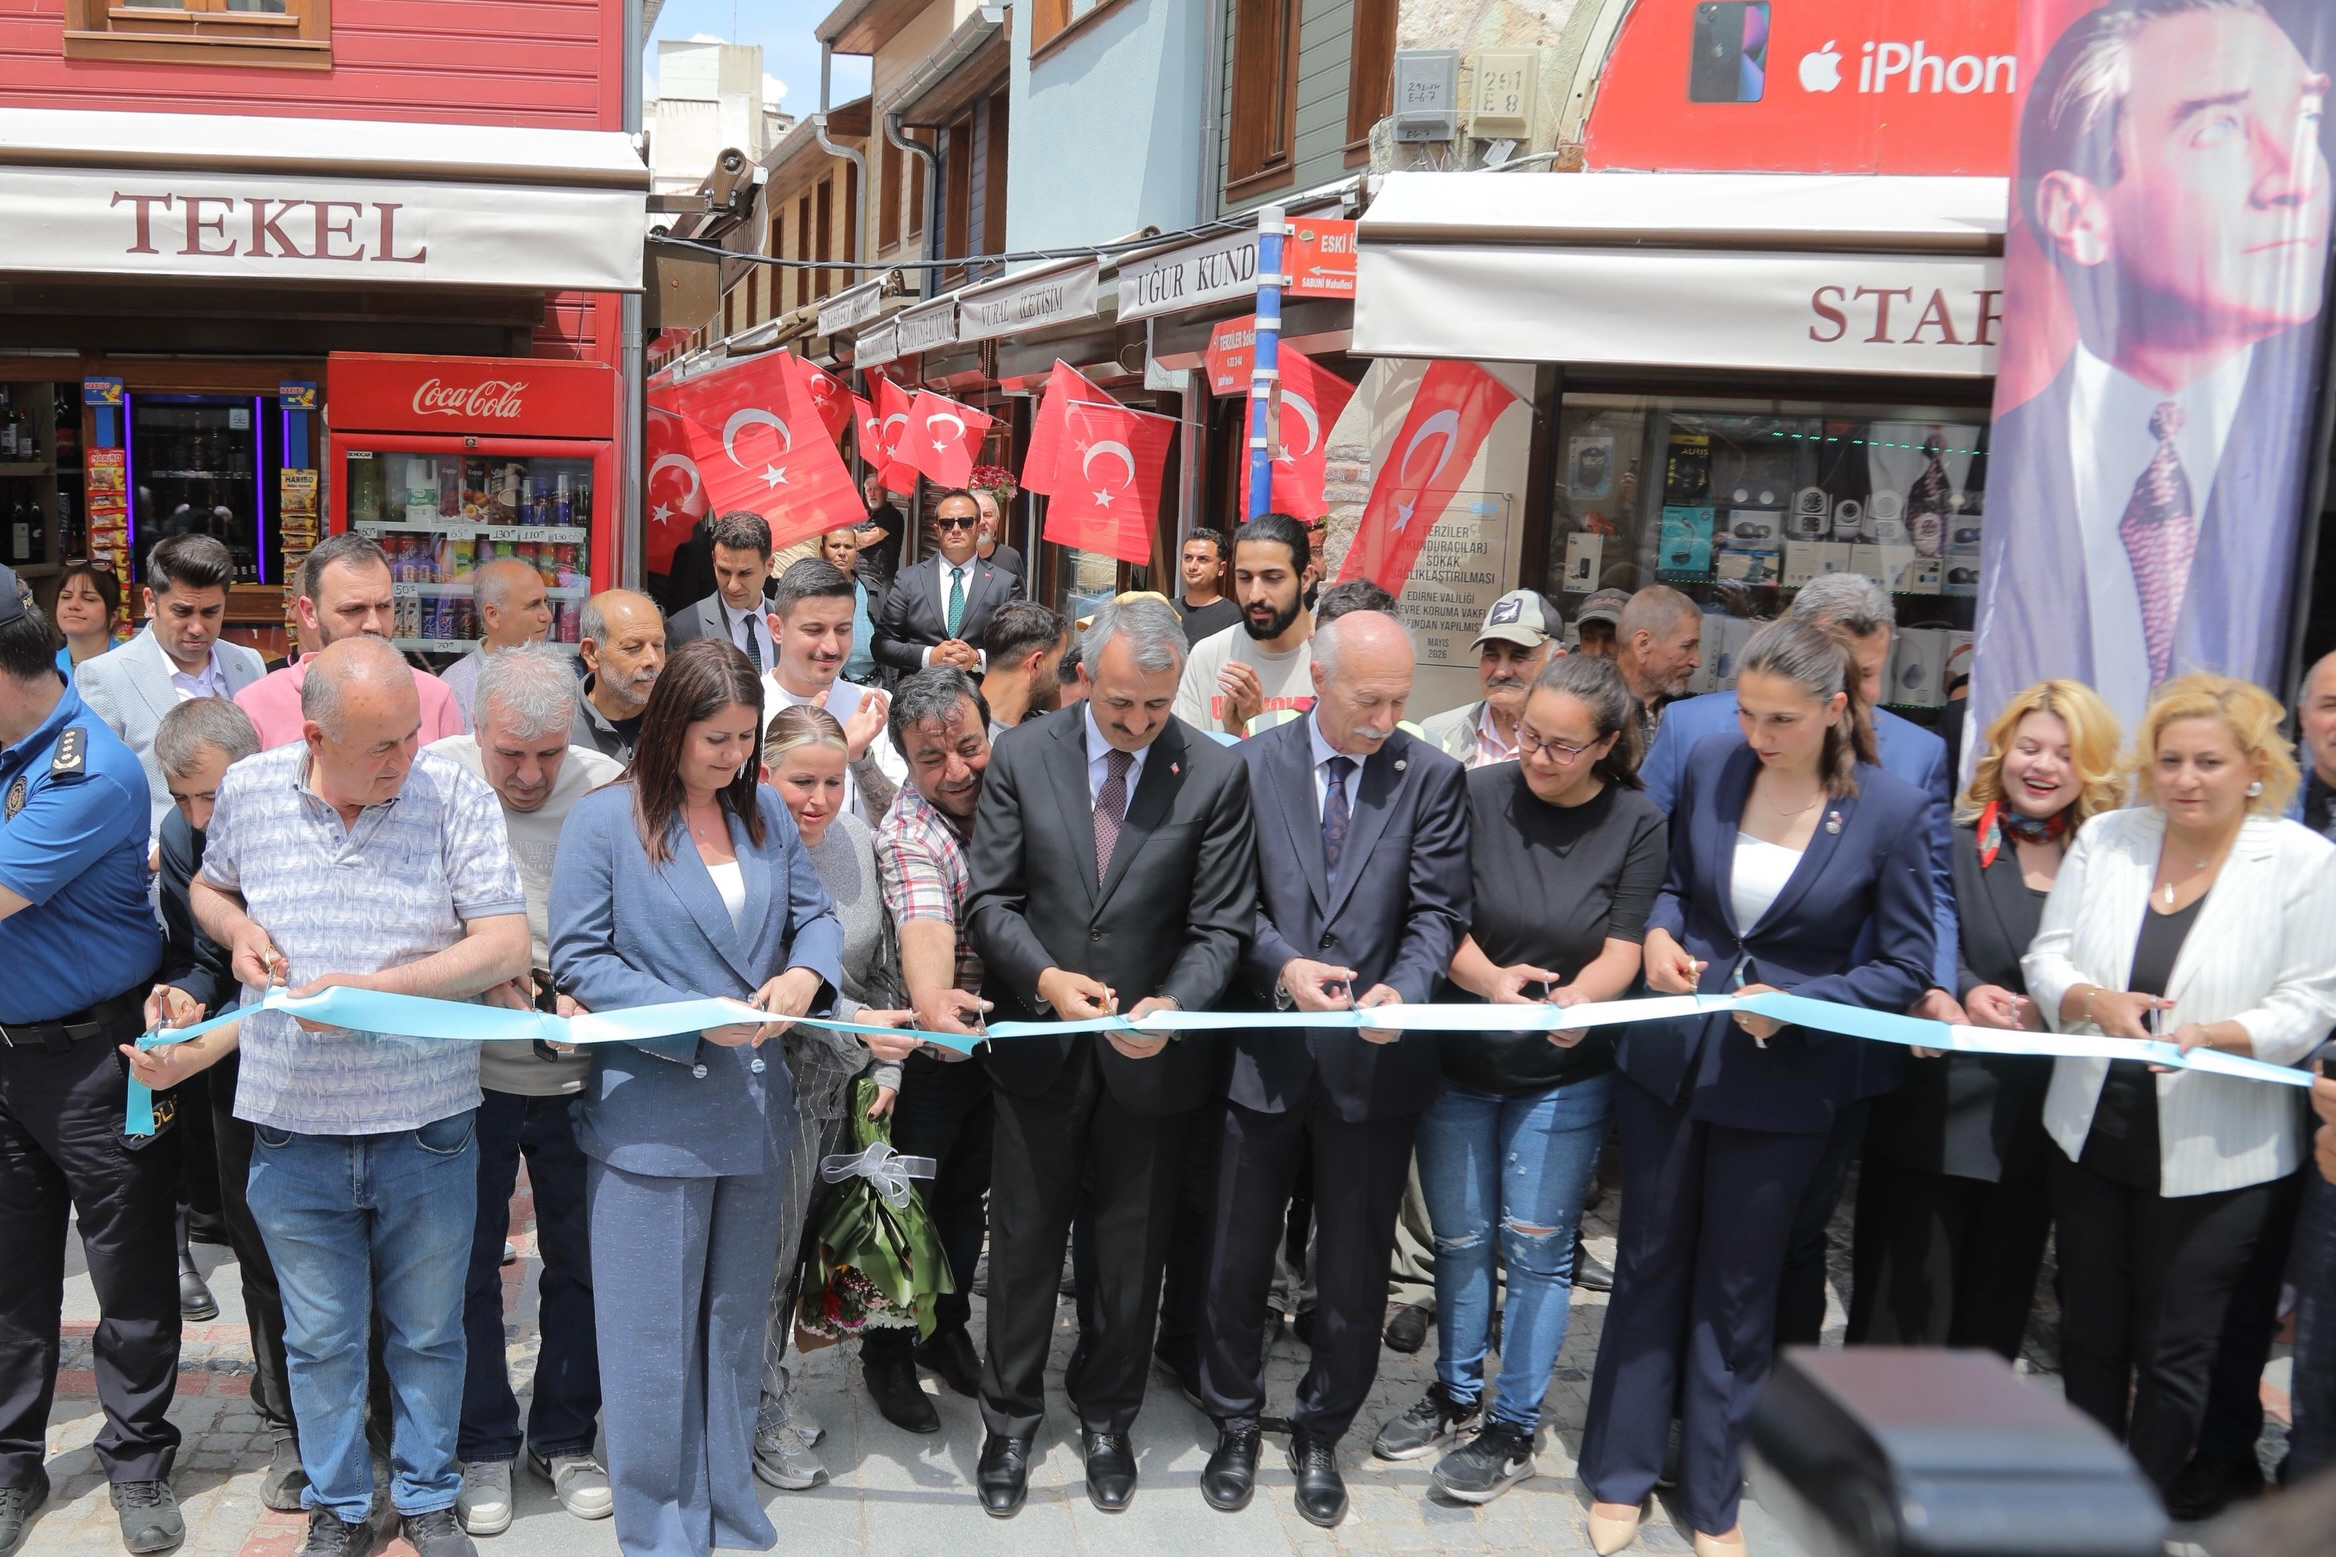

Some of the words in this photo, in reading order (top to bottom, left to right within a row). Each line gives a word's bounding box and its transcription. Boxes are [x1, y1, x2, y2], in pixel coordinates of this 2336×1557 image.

[1857, 39, 2017, 94] iPhon
[110, 190, 427, 264] TEKEL
[1321, 231, 1347, 253] ESKİ
[1137, 260, 1185, 307] UĞUR
[1196, 243, 1256, 292] KUND
[1301, 276, 1325, 289] SABUNİ
[1325, 278, 1353, 290] Mahallesi
[981, 300, 1009, 328] VURAL
[1019, 283, 1065, 321] İLETİŞİM
[1220, 329, 1243, 352] TERZİLER
[1243, 329, 1256, 347] Soka
[84, 381, 111, 390] HARIBO
[279, 386, 305, 395] HARIBO
[412, 378, 530, 418] Coca-Cola
[91, 453, 122, 463] HARIBO
[1680, 448, 1709, 456] AURIS
[285, 476, 314, 484] HARIBO
[1422, 524, 1469, 538] TERZİLER
[1426, 555, 1461, 568] SOKAK
[1407, 590, 1438, 602] EDİRNE
[1440, 592, 1475, 604] VALİLİĞİ
[1400, 604, 1421, 615] EVRE
[1423, 605, 1459, 617] KORUMA
[1404, 619, 1438, 630] FINDAN
[1427, 637, 1449, 648] MAYIS
[1428, 649, 1448, 659] 2026
